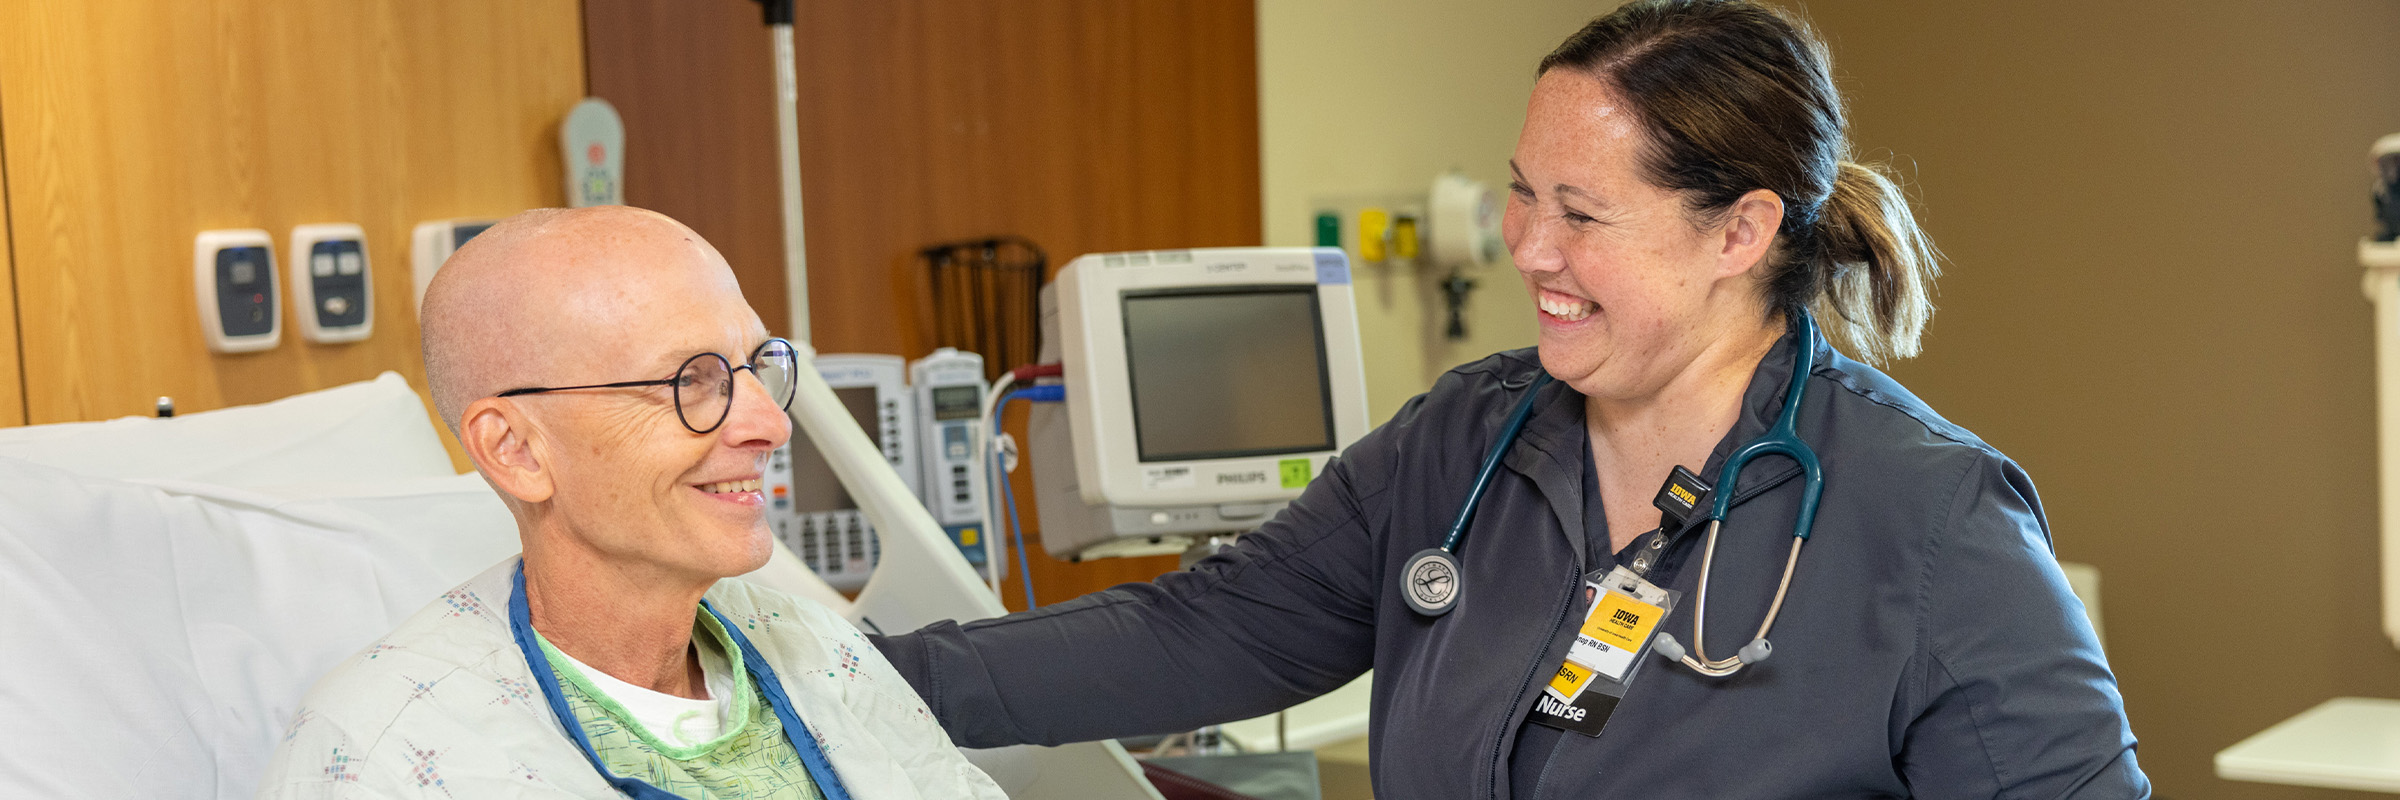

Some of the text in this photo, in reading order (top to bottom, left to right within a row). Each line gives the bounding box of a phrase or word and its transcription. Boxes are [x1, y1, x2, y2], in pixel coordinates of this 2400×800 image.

[1217, 471, 1267, 484] PHILIPS
[1670, 483, 1696, 505] IOWA
[1613, 608, 1640, 625] IOWA
[1588, 639, 1598, 648] RN
[1535, 695, 1587, 722] Nurse
